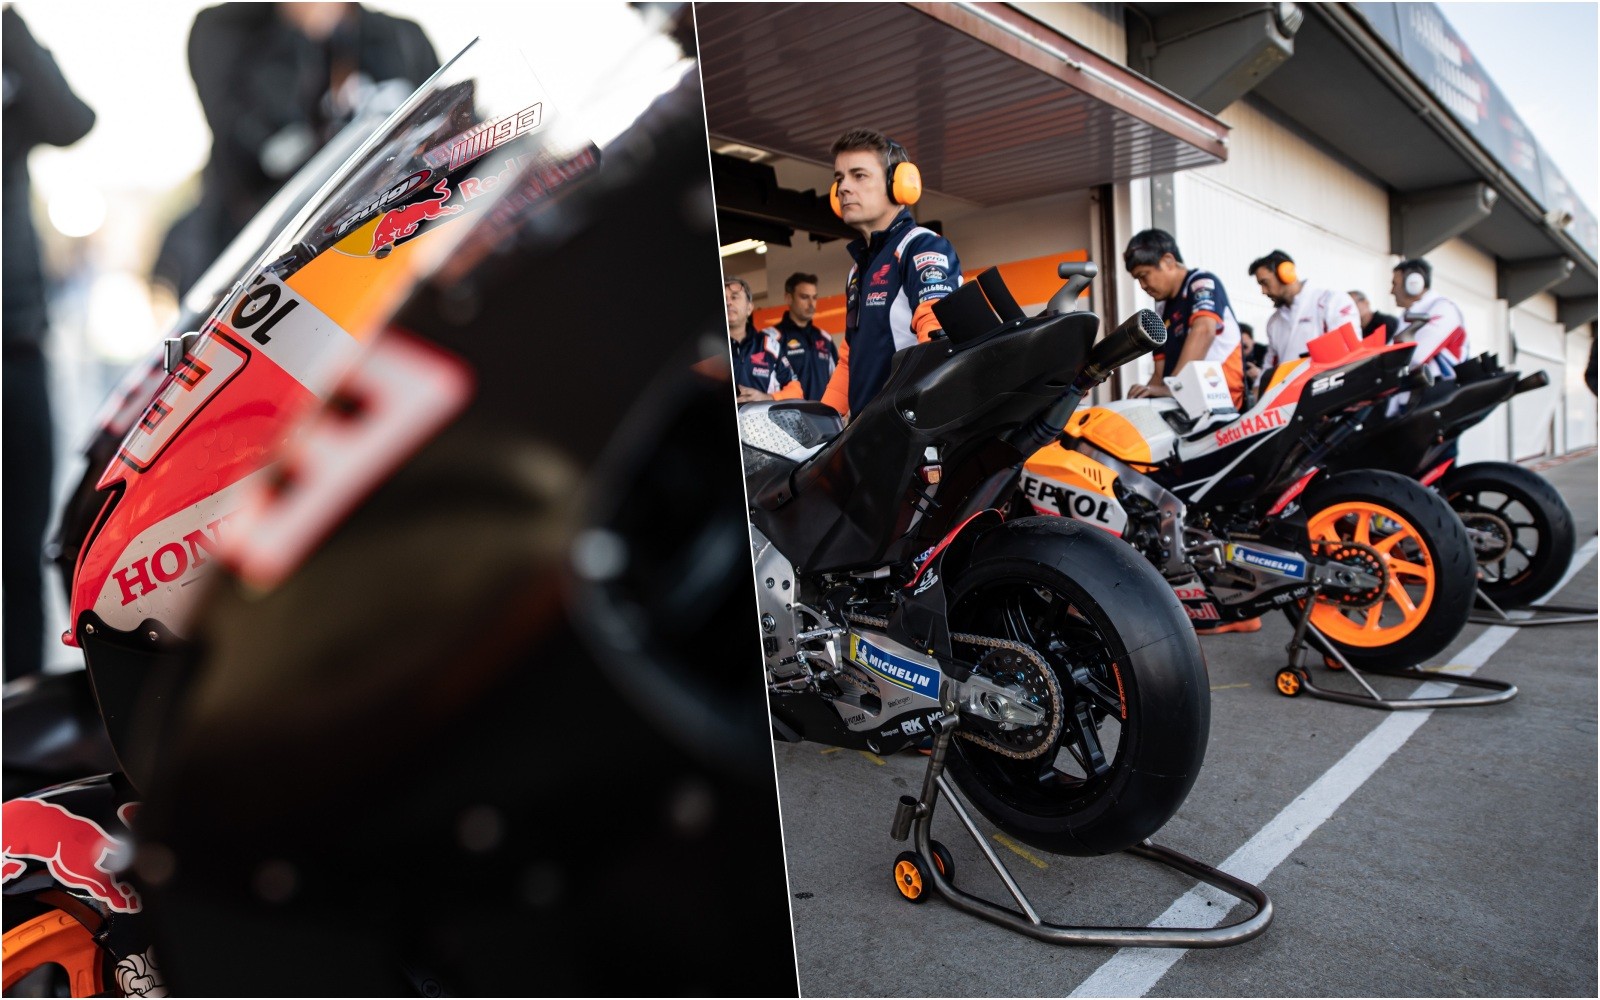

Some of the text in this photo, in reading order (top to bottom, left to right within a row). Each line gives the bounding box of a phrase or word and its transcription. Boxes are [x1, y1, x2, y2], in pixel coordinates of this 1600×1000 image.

[458, 158, 515, 202] Red
[229, 276, 299, 346] OL
[1215, 426, 1241, 448] Satu
[112, 517, 229, 607] HON
[1245, 554, 1298, 573] MICHELIN
[1184, 601, 1221, 621] Bull
[869, 654, 931, 687] MICHELIN
[901, 717, 925, 735] RK
